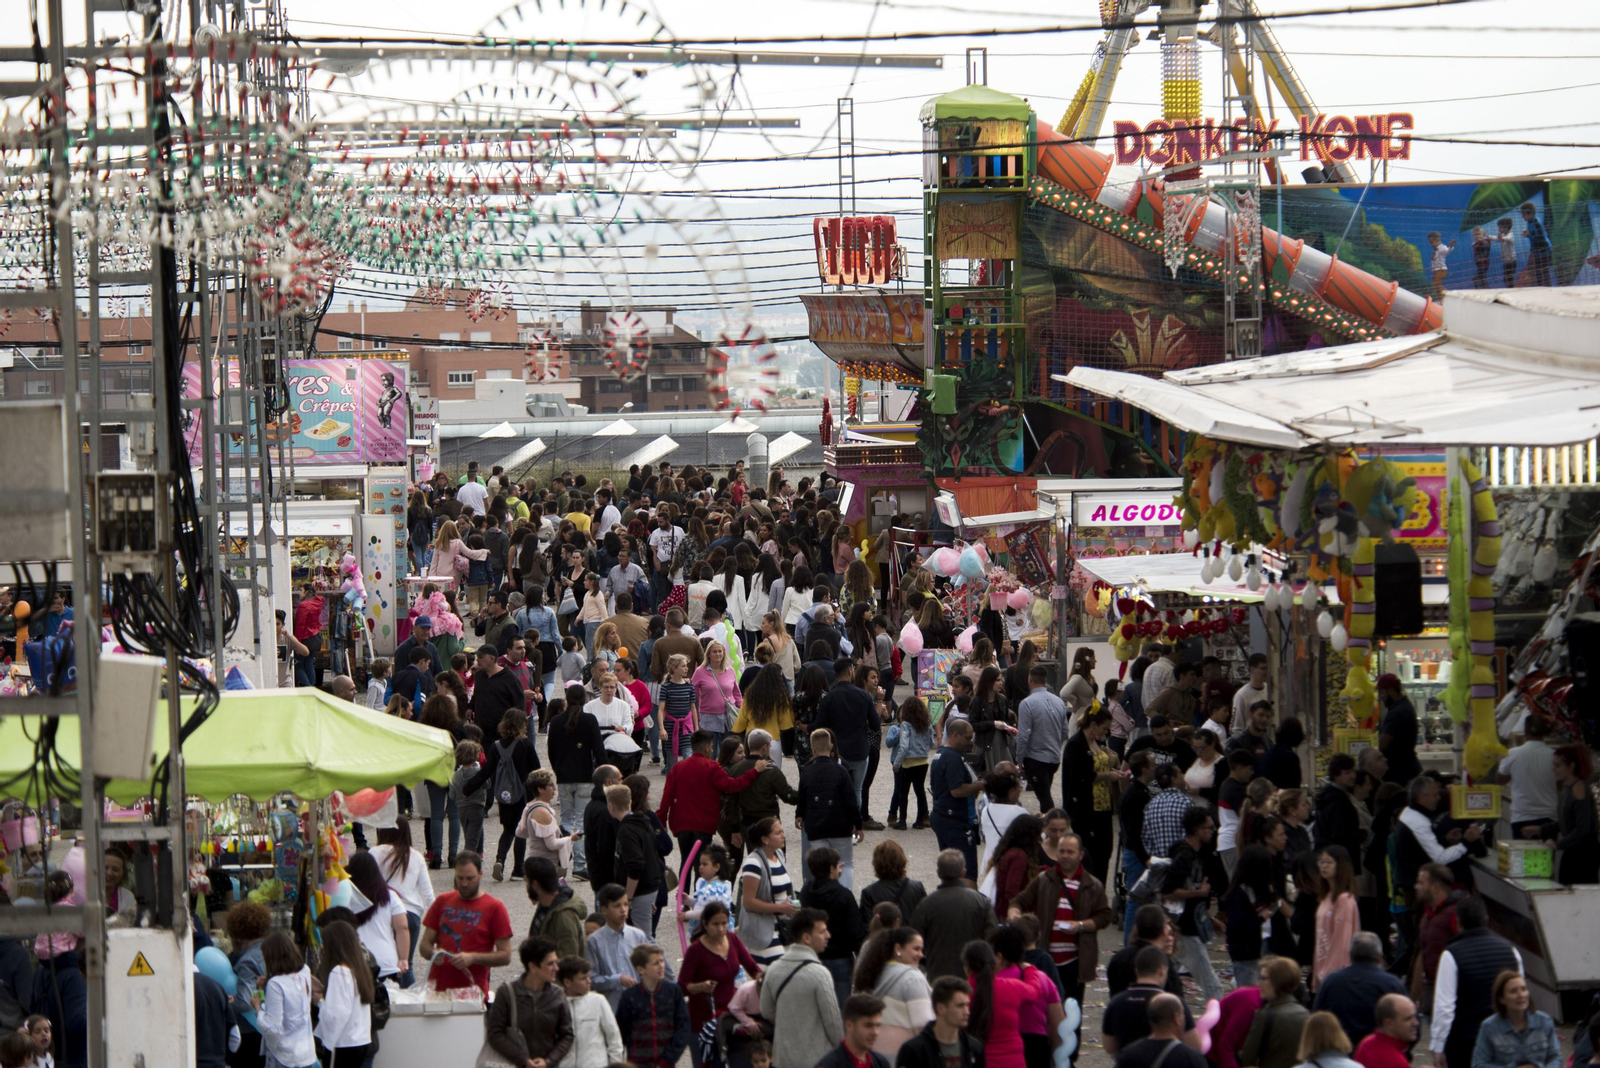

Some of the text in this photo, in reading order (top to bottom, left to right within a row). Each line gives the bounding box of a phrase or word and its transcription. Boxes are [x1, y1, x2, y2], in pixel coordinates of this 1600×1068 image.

[1113, 112, 1415, 166] DONKEY KONG
[340, 382, 354, 396] &
[299, 398, 358, 416] Crêpes
